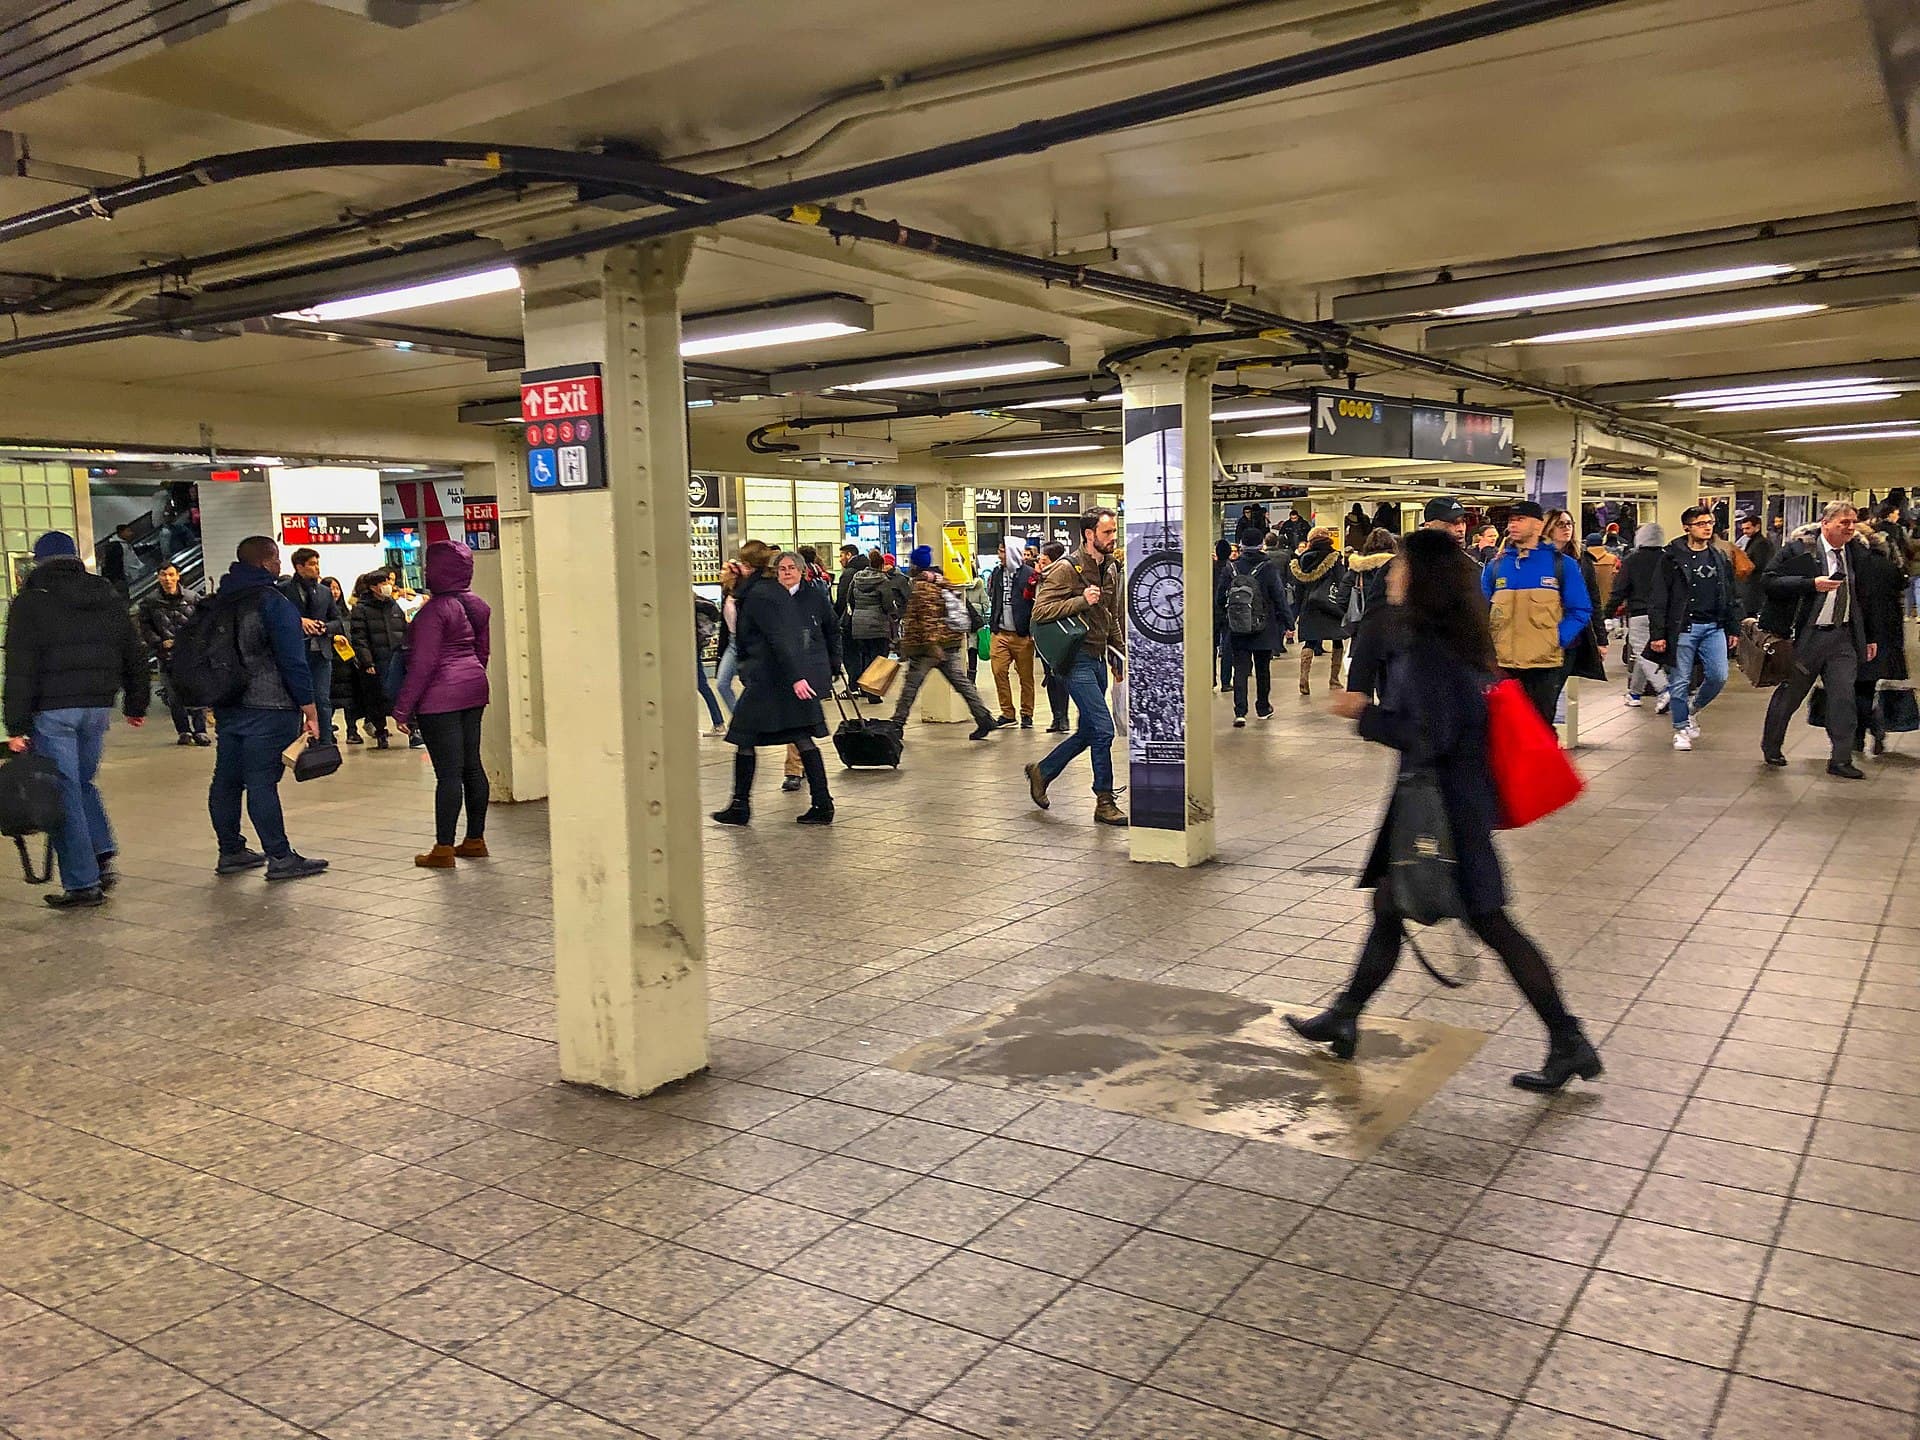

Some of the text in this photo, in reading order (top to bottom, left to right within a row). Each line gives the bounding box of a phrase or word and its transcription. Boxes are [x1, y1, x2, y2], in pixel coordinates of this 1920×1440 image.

[543, 383, 589, 415] Exit
[473, 505, 493, 519] Exit
[284, 517, 306, 528] Exit
[309, 526, 318, 534] 42
